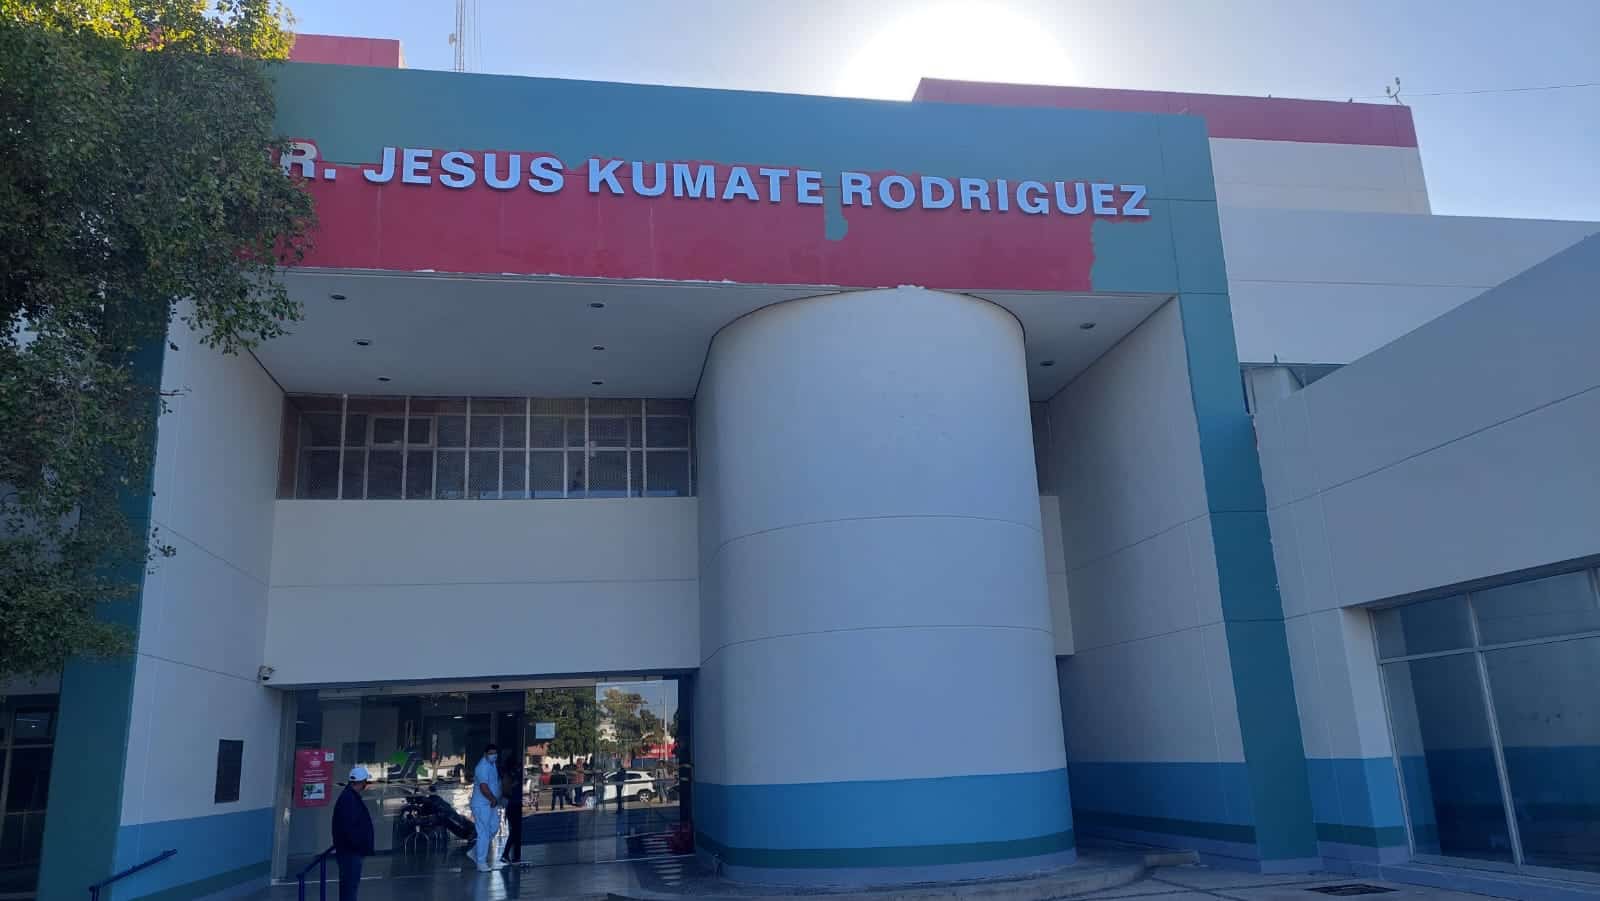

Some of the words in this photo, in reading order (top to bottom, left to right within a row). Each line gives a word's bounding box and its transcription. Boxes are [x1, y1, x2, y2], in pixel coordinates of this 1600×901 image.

[268, 141, 336, 180] R.
[363, 146, 565, 193] JESUS
[588, 157, 824, 205] KUMATE
[840, 171, 1151, 217] RODRIGUEZ
